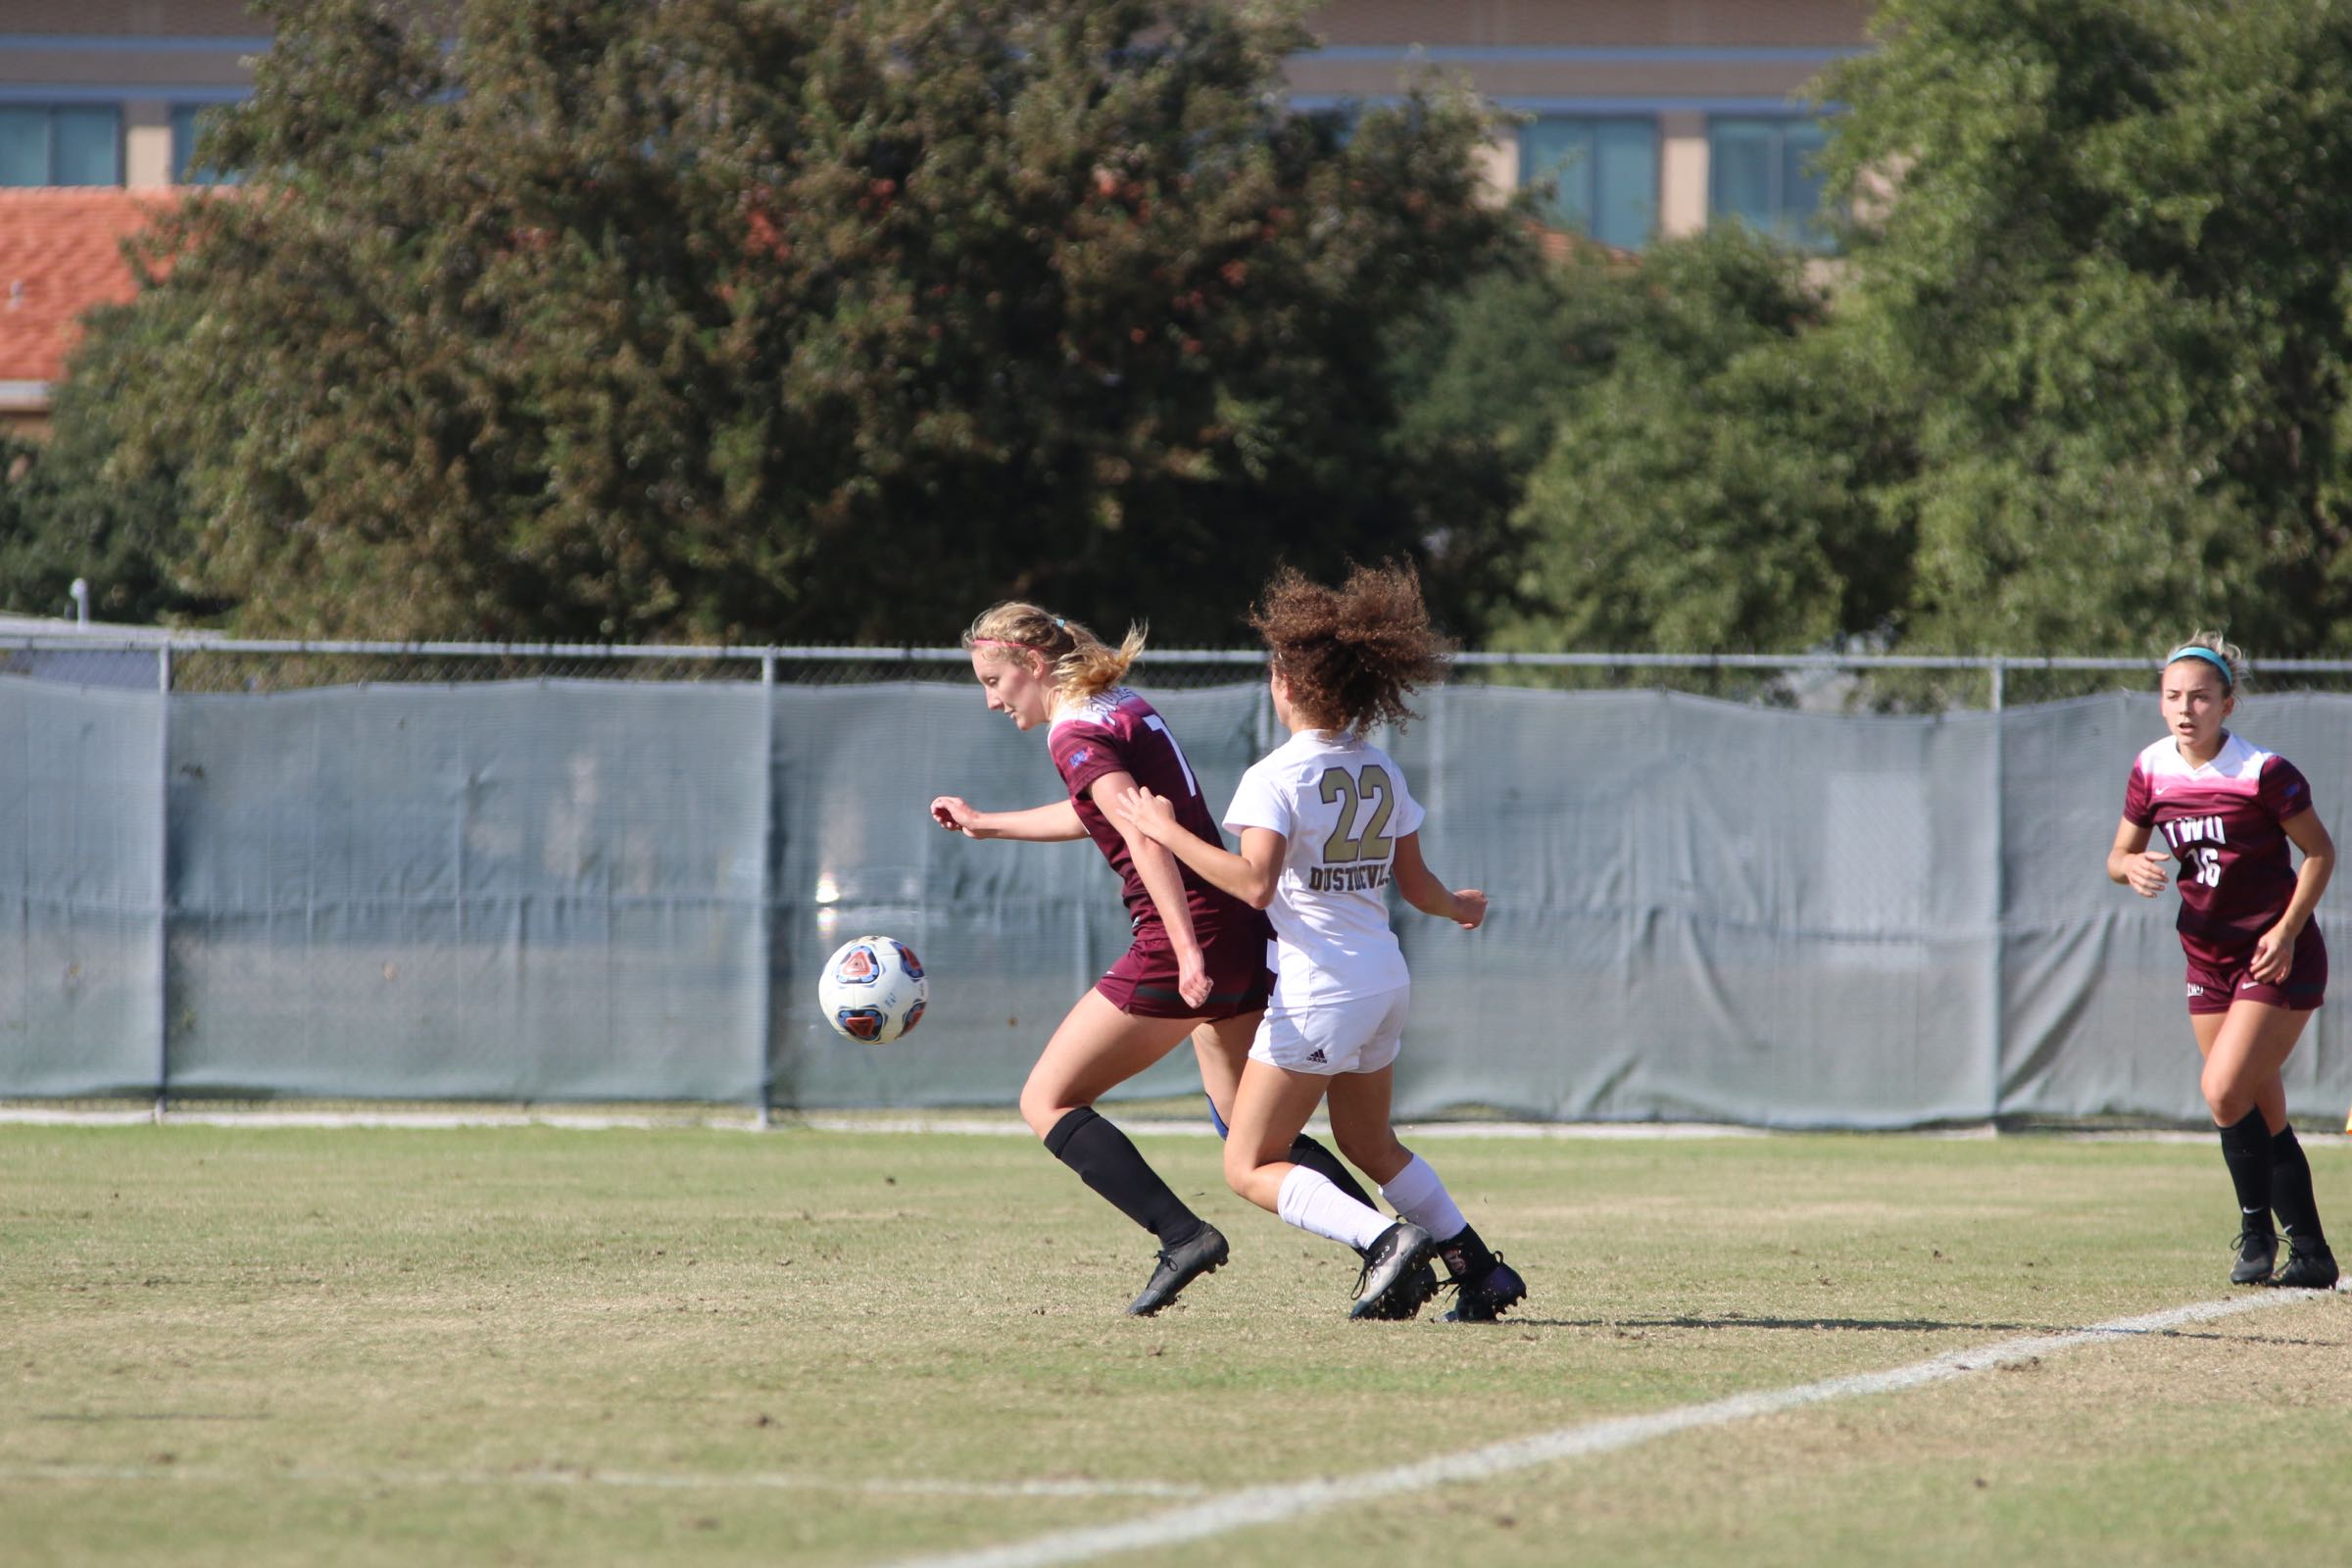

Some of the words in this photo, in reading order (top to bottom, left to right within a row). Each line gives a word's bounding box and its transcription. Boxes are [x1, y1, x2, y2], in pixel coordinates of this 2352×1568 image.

[1319, 764, 1395, 863] 22
[2165, 815, 2227, 849] TWU
[2185, 847, 2222, 888] 16
